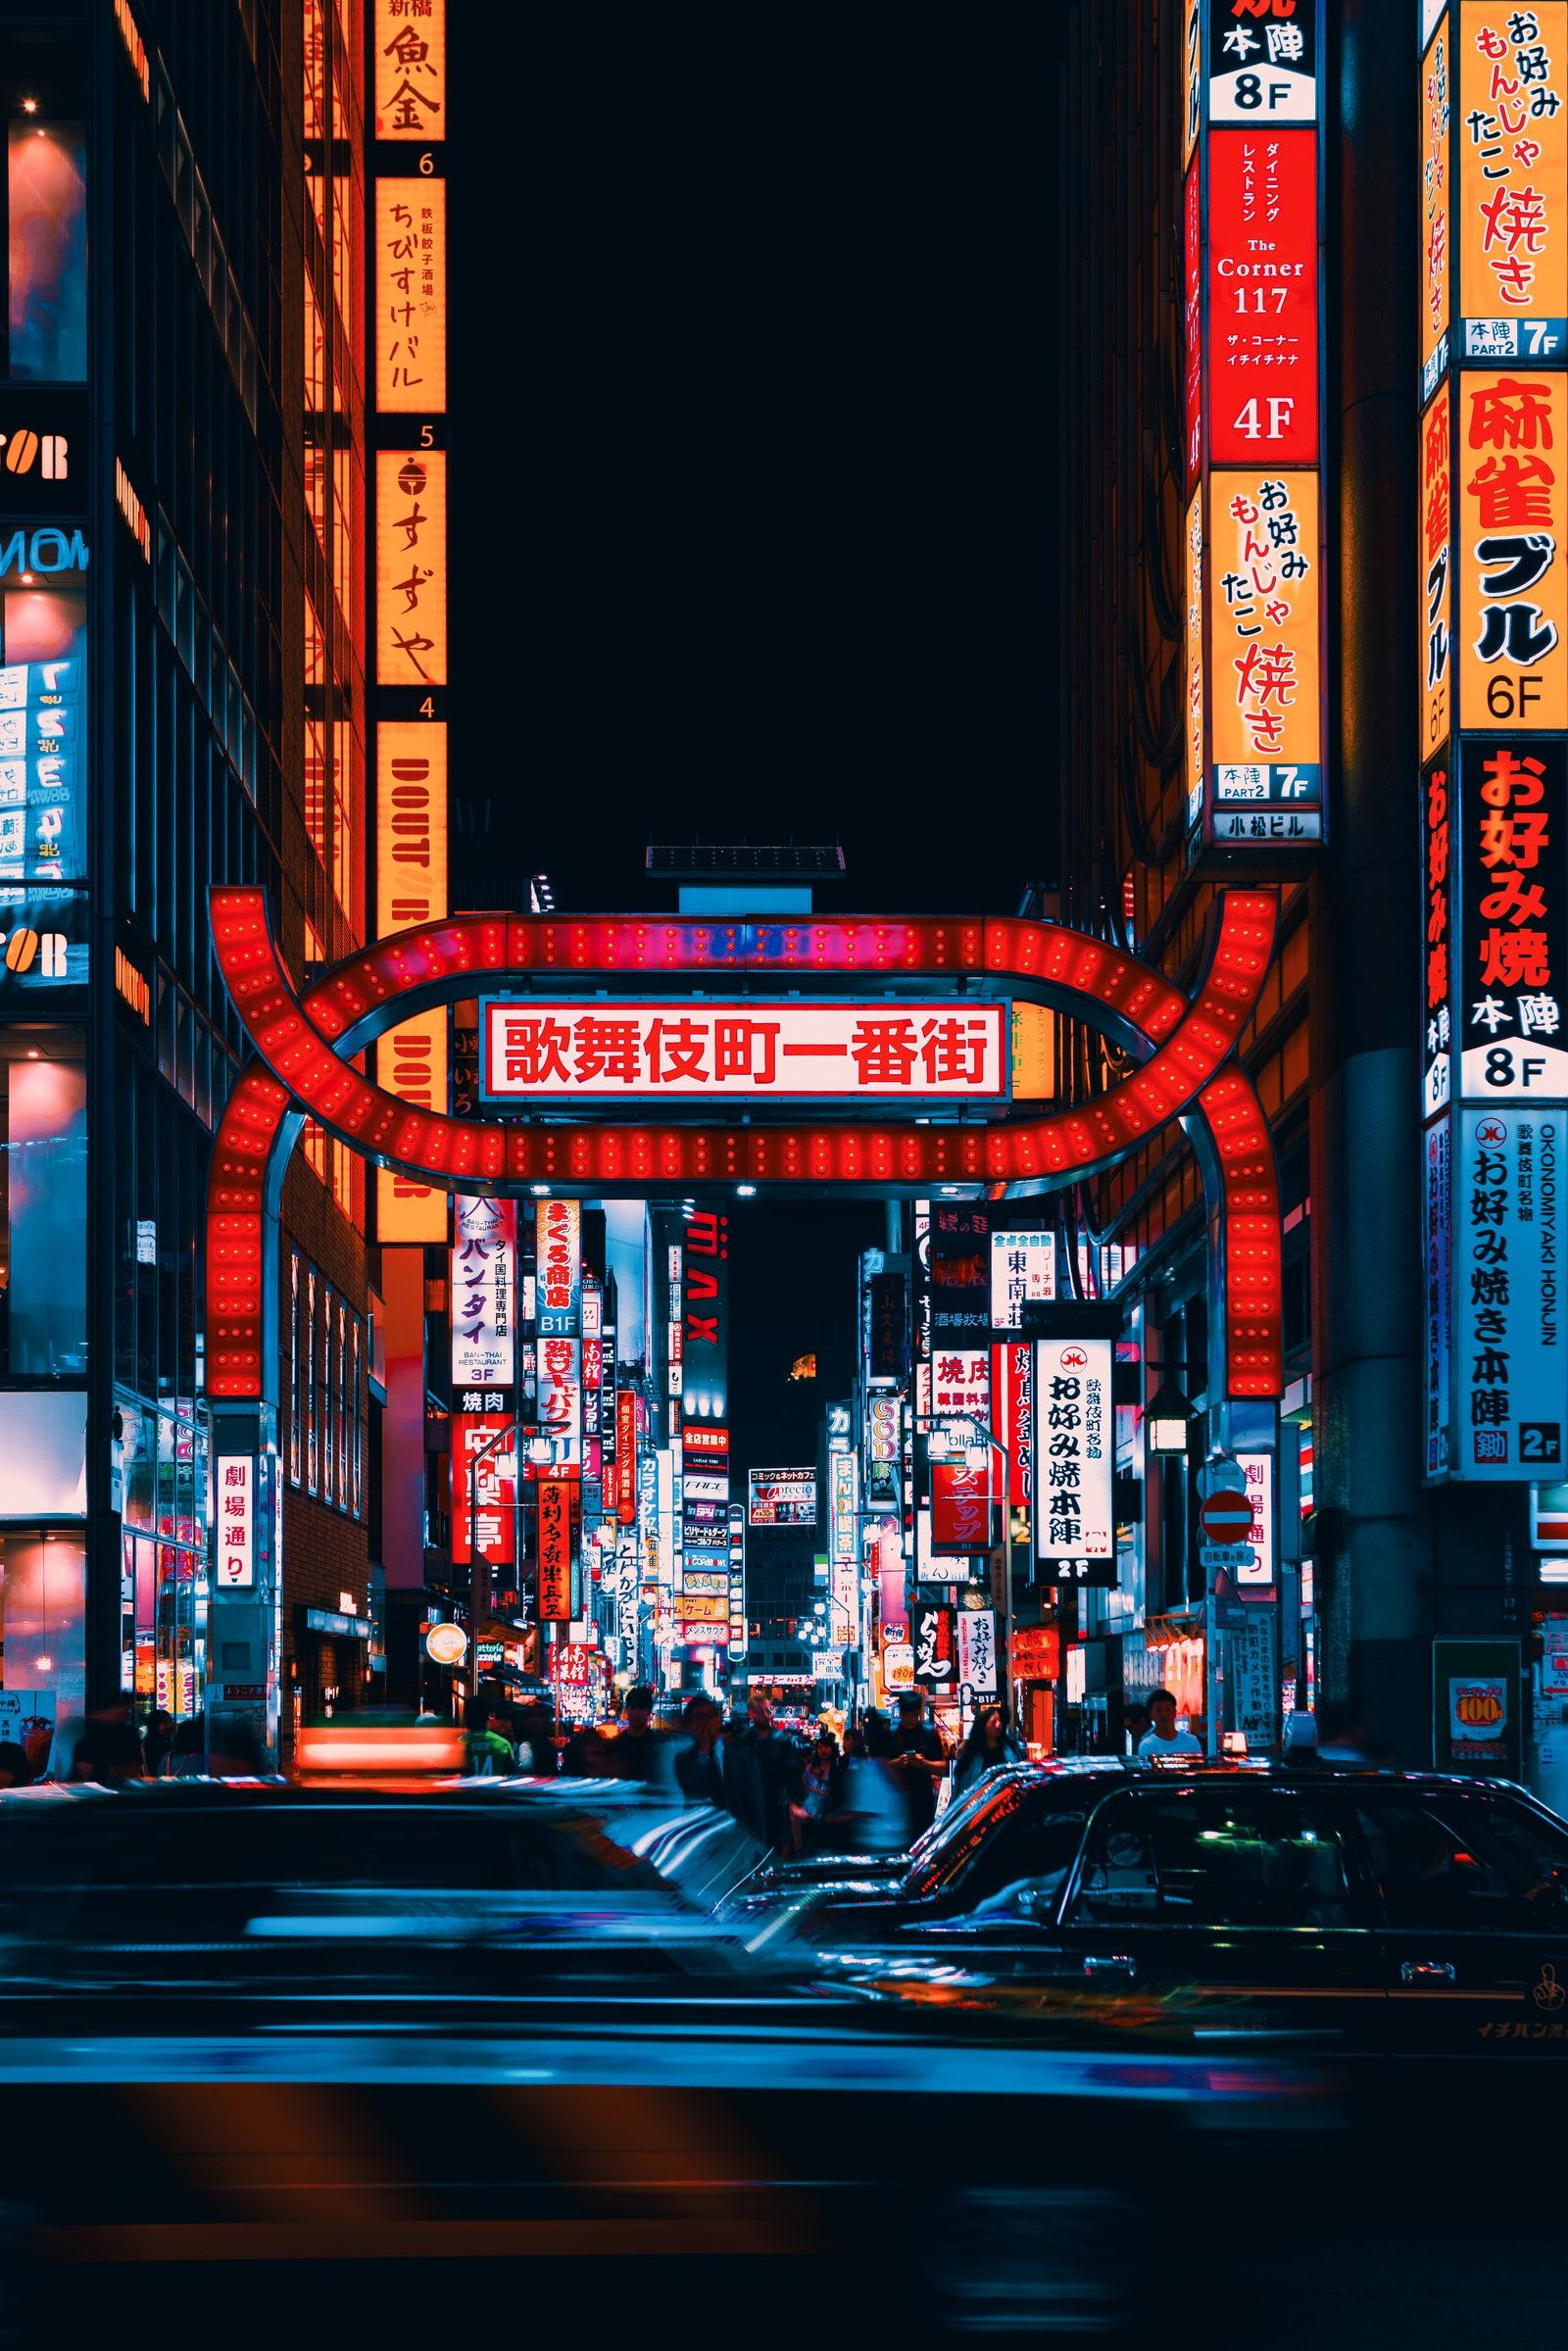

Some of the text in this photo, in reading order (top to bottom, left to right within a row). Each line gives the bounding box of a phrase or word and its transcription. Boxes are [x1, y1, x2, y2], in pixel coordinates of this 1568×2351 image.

[1223, 24, 1304, 62] 本陣
[1507, 12, 1560, 118] お好み
[383, 24, 440, 129] 魚金
[1234, 73, 1292, 111] 8F
[1477, 27, 1540, 167] もんじゃ
[418, 154, 434, 174] 6
[1467, 111, 1510, 178] たこ
[1243, 143, 1255, 222] レストラン
[1265, 142, 1280, 222] ダイニング
[420, 207, 433, 297] 鉄板餃子酒場
[1217, 258, 1303, 277] Corner
[1248, 240, 1276, 252] The
[1481, 186, 1548, 305] 焼き
[387, 203, 423, 388] ちびすけバル
[1234, 288, 1288, 314] 117
[1227, 335, 1298, 346] ザ・コーナー
[1471, 321, 1510, 340] 本陣
[1471, 343, 1515, 355] PART2
[1524, 321, 1558, 354] 7F
[1227, 355, 1298, 366] イチイチナナ
[420, 426, 433, 447] 5
[1234, 397, 1294, 439] 4F
[0, 429, 68, 479] OR
[1259, 480, 1308, 578] お好み
[1230, 496, 1290, 625] もんじゃ
[391, 503, 435, 679] すずや
[1221, 572, 1262, 636] たこ
[419, 697, 434, 718] 4
[1235, 643, 1298, 753] 焼き
[1487, 674, 1544, 719] 6F
[1225, 785, 1264, 798] PART2
[1276, 767, 1308, 798] 7F
[391, 759, 430, 921] DOUTOR
[1229, 814, 1304, 838] 小松ビル
[1480, 750, 1551, 988] お好み焼
[0, 927, 68, 978] OR
[1472, 992, 1560, 1036] 本陣
[504, 1017, 988, 1086] 歌舞伎町一番街
[1485, 1047, 1546, 1088] 8F
[1517, 1124, 1534, 1222] 歌舞伎町名物
[546, 1202, 572, 1310] まぐろ商店
[994, 1235, 1053, 1248] 全卓全自動
[1540, 1124, 1556, 1347] OKONOMIYAKI HONJIN
[460, 1238, 490, 1345] バンタイ
[495, 1240, 508, 1337] タイ国料理専門店
[1470, 1151, 1511, 1428] お好み焼き本陣
[541, 1316, 575, 1331] B1F
[471, 1369, 494, 1381] 3F
[463, 1392, 504, 1412] 焼肉
[1524, 1428, 1558, 1456] 2F
[549, 1465, 570, 1478] 4F
[224, 1465, 247, 1576] 劇場通り
[1058, 1560, 1089, 1578] 2F
